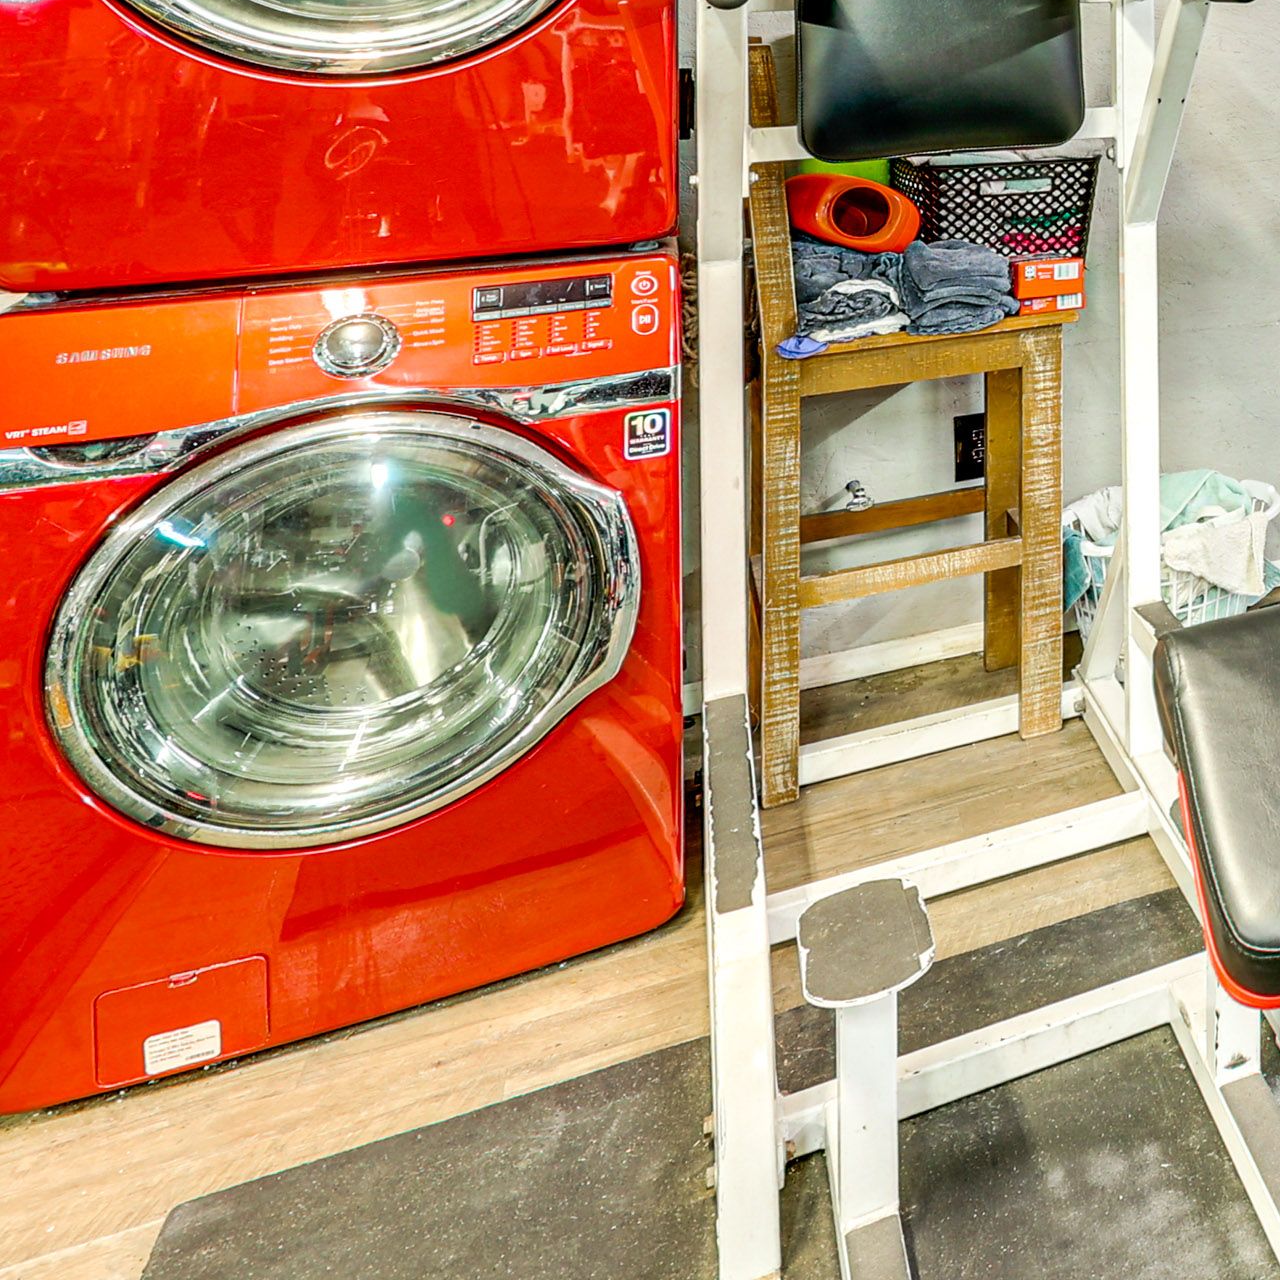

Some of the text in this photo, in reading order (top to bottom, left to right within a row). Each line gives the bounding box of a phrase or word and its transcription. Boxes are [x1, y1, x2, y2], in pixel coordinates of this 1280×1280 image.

[56, 344, 151, 364] SAMSUNG
[31, 425, 67, 437] STEAM
[630, 413, 663, 436] 10
